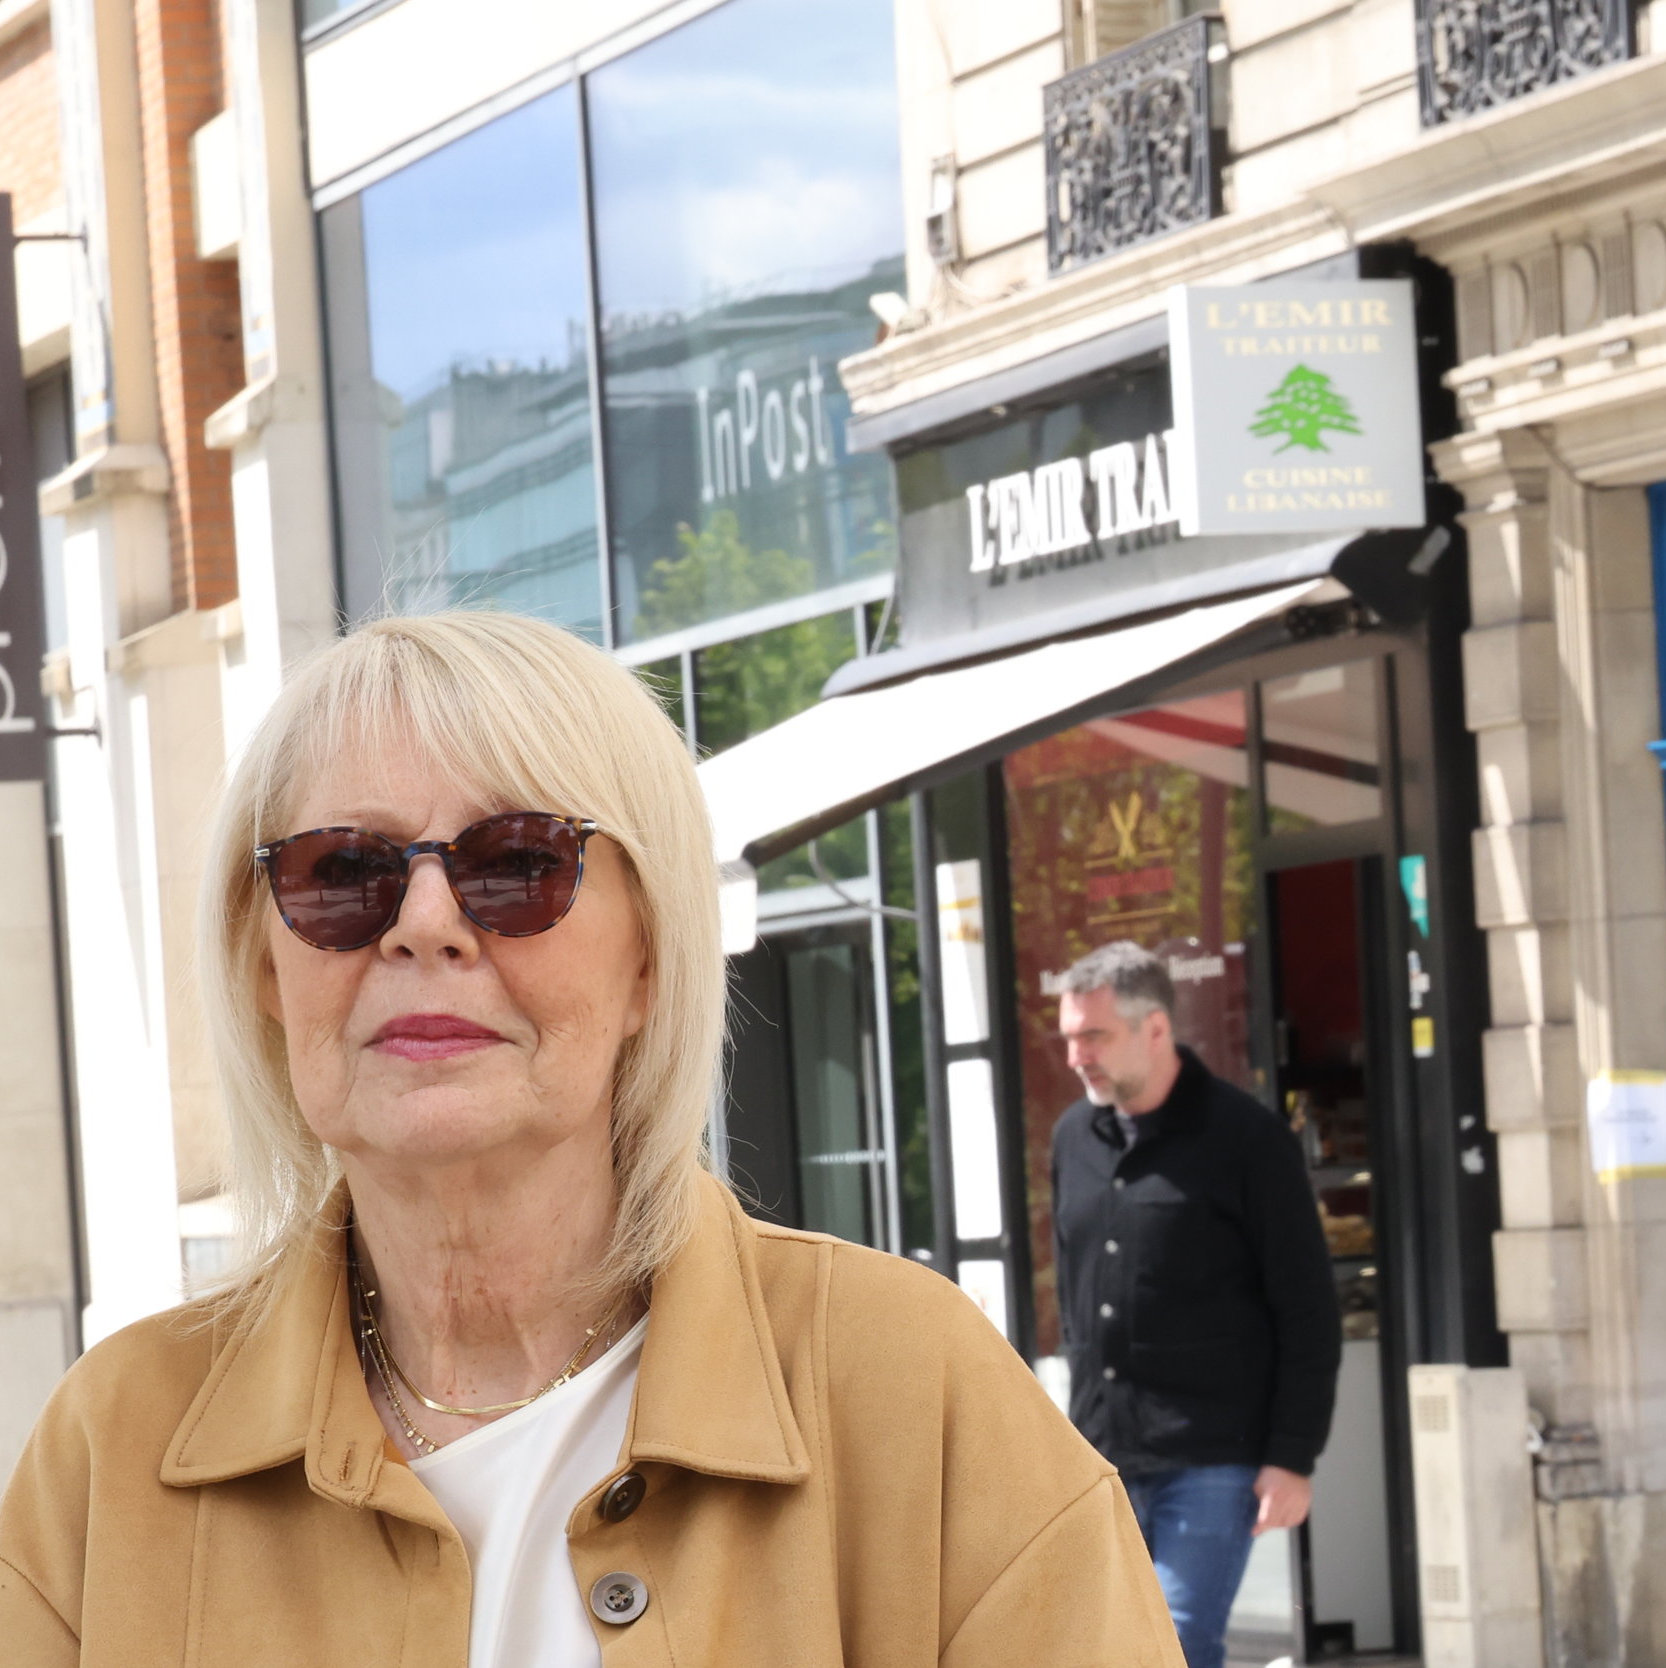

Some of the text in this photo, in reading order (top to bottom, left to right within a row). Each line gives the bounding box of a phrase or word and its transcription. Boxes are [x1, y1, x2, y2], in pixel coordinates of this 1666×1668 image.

[1205, 299, 1394, 329] L'EMIR
[1222, 333, 1383, 356] TRAITEUR
[696, 355, 829, 504] InPost
[1242, 466, 1373, 489] CUISINE
[1226, 488, 1393, 513] LIBANAISE
[966, 457, 1092, 573] L'EMIR
